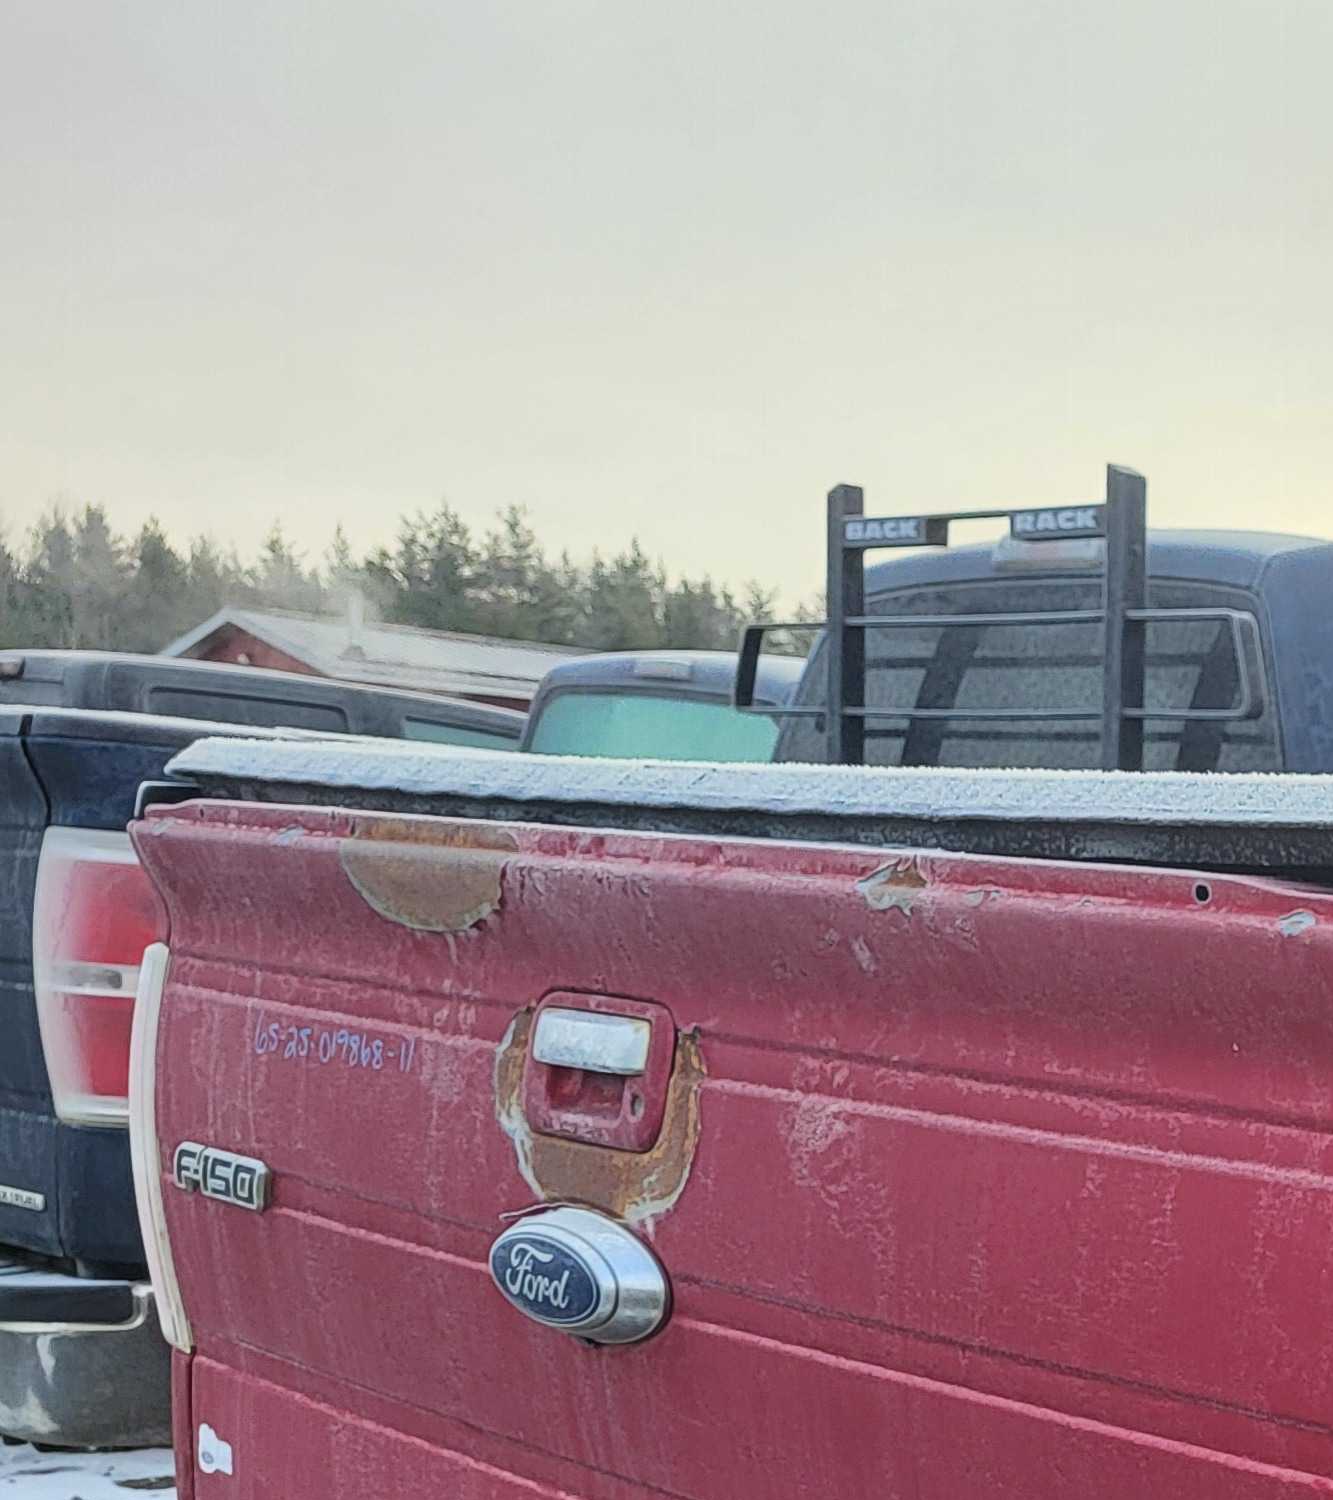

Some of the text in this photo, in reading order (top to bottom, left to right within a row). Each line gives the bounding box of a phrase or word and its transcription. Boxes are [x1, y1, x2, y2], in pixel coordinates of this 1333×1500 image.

[844, 507, 1096, 540] BACK RACK
[505, 1243, 569, 1309] Ford
